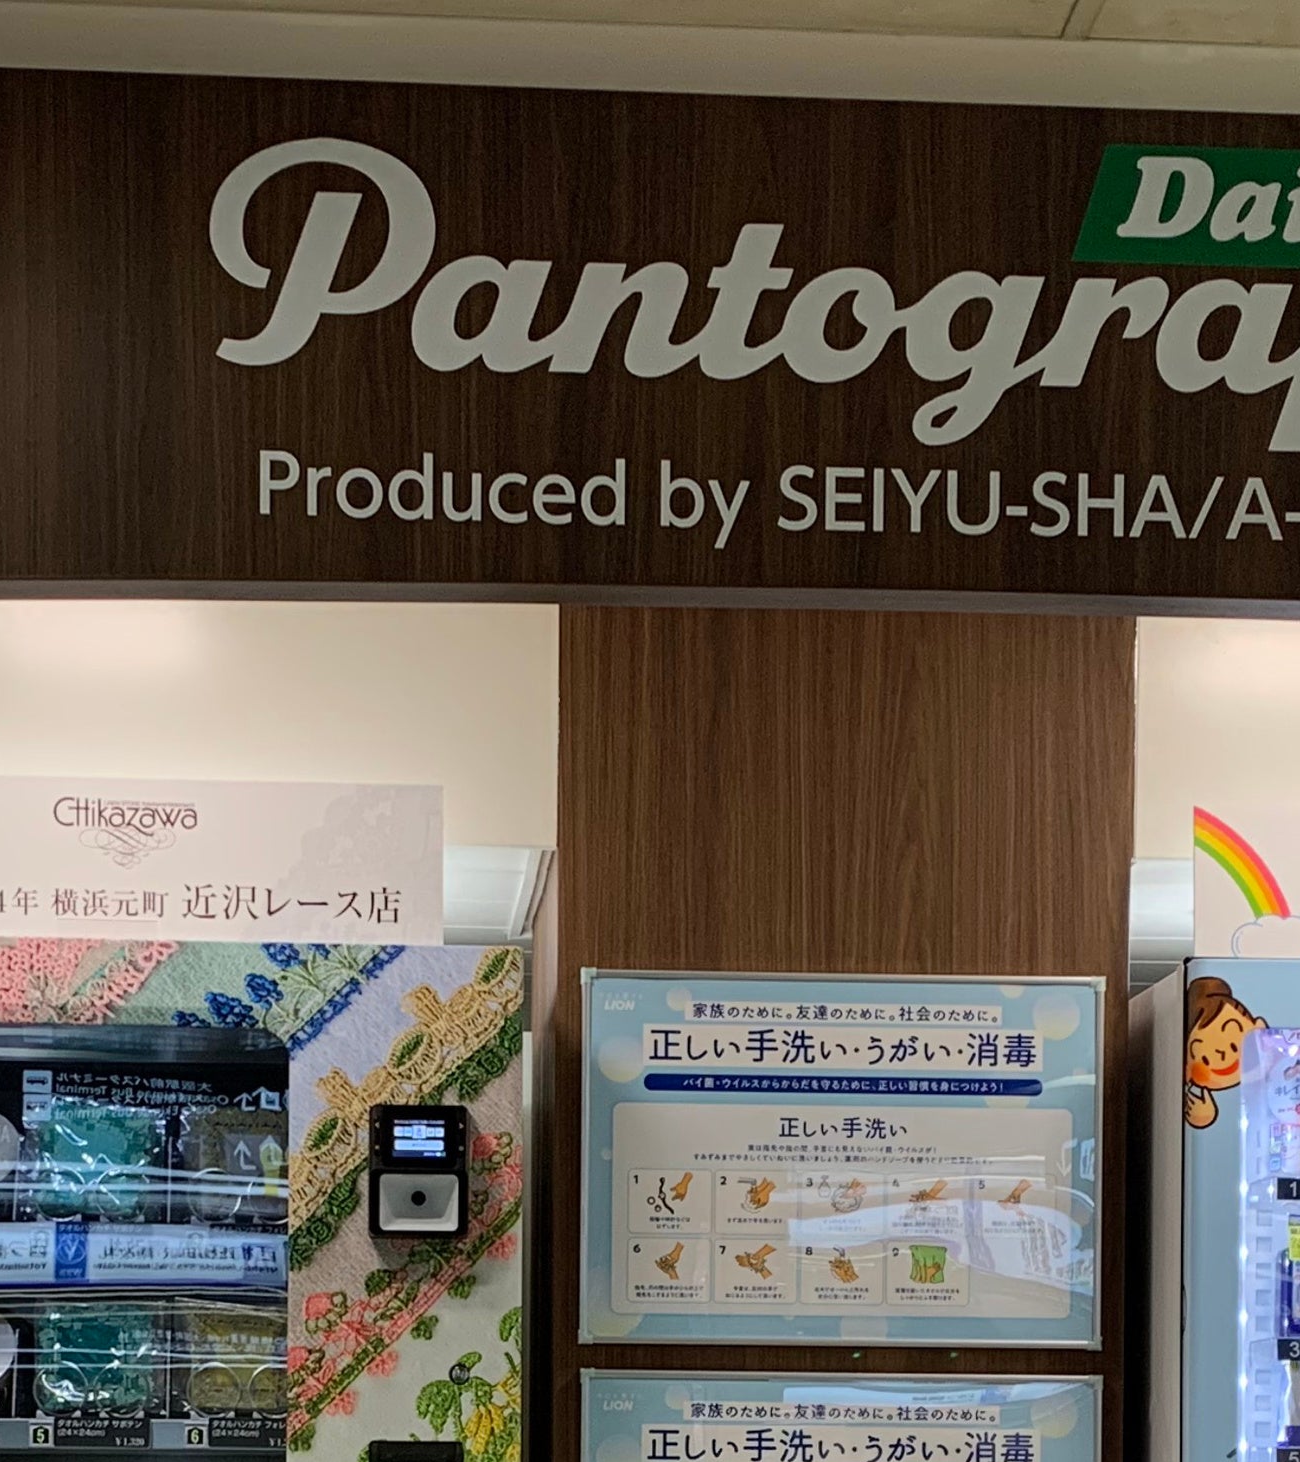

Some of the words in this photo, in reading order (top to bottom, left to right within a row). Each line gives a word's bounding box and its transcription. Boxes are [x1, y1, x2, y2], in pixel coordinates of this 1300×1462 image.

[255, 450, 628, 528] Produced
[656, 458, 751, 550] by
[51, 888, 167, 919] 横浜元町
[181, 883, 403, 925] 近沢レース店
[692, 1002, 1000, 1024] 家族のために。友達のために。社会のために。
[648, 1028, 1038, 1068] 正しい手洗い・うがい・消毒
[778, 1116, 908, 1140] 正しい手洗い
[1289, 1182, 1298, 1197] 1
[1288, 1342, 1300, 1357] 3
[602, 1400, 634, 1412] LION
[689, 1402, 998, 1423] 家族のために。友達のために。社会のために。
[57, 1419, 109, 1429] タオルハンカチ
[111, 1420, 143, 1429] サボテン
[211, 1419, 262, 1429] タオルハンカチ
[35, 1427, 45, 1443] 5
[190, 1428, 200, 1444] 6
